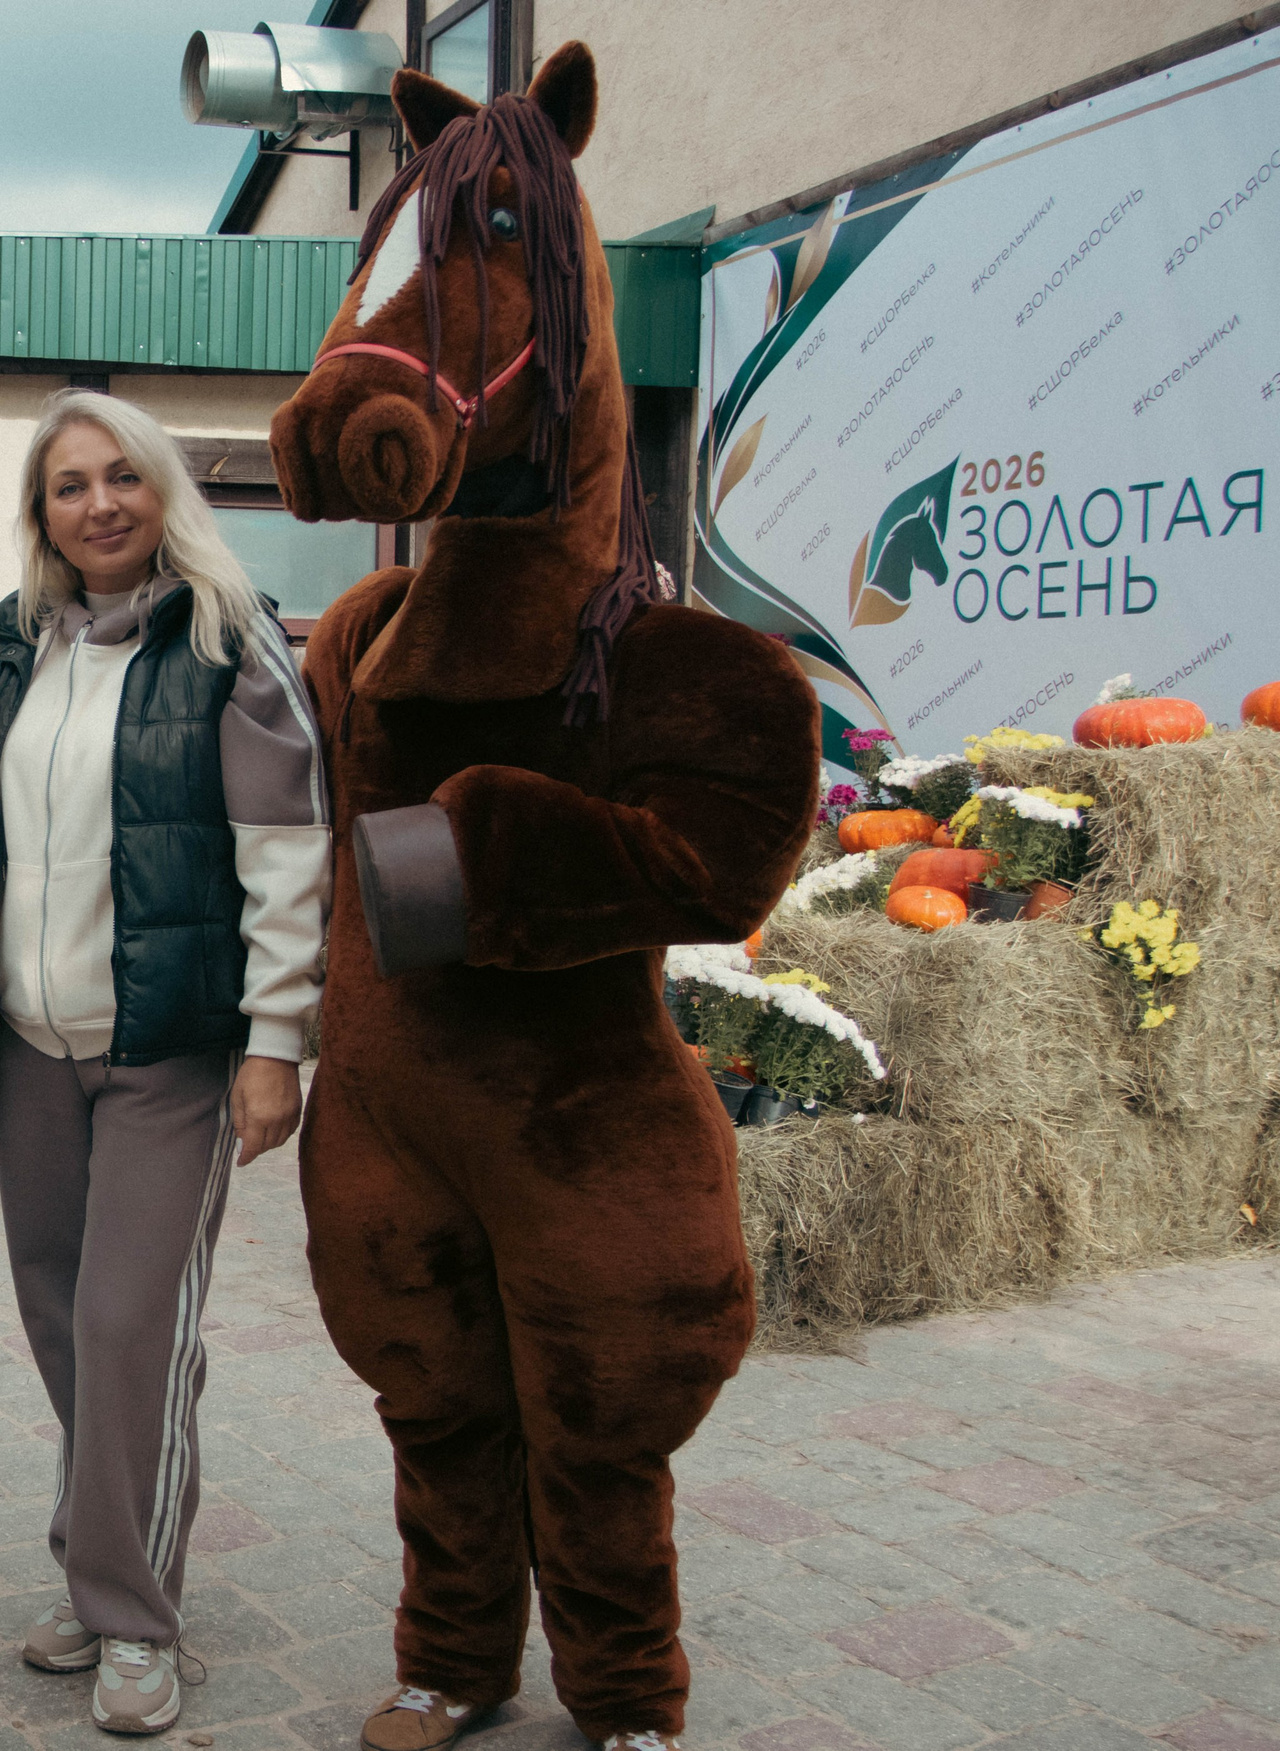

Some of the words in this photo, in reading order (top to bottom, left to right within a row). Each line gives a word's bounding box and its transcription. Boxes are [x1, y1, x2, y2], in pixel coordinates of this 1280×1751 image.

[970, 196, 1056, 294] #Котельники
[1015, 188, 1144, 328] #ЗОЛОТАЯОСЕНЬ
[860, 262, 936, 354] #СШОРБелка
[796, 328, 827, 371] #2026
[1028, 311, 1123, 411] #СШОРБелка
[1132, 314, 1240, 416] #Котельники
[837, 336, 934, 448] #ЗОЛОТАЯОСЕНЬ
[753, 414, 812, 488] #Котельники
[884, 388, 963, 474] #СШОРБелка
[755, 468, 817, 541] #СШОРБелка
[960, 450, 1045, 497] 2026
[800, 523, 831, 562] #2026
[958, 468, 1264, 560] ЗОЛОТАЯ
[953, 555, 1158, 624] ОСЕНЬ
[890, 639, 924, 678] #2026
[907, 659, 983, 730] #Котельники
[993, 672, 1074, 728] ТАЯОСЕНЬ
